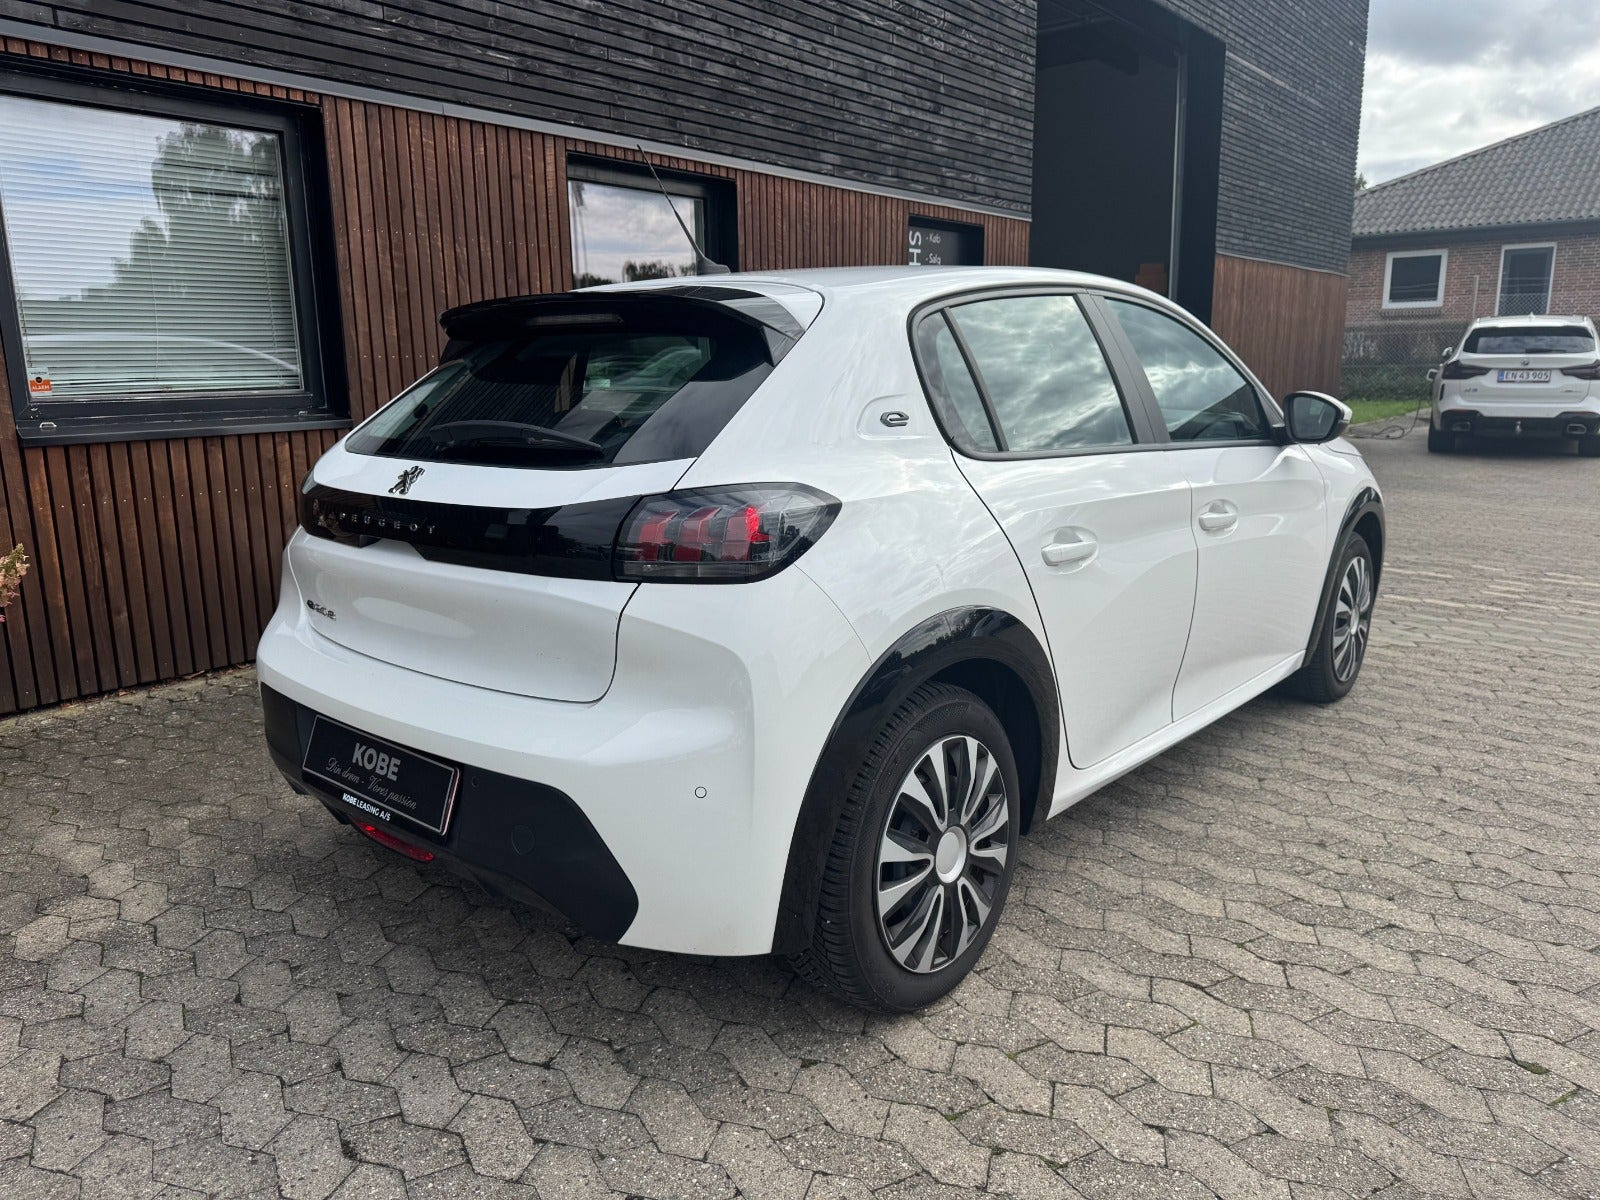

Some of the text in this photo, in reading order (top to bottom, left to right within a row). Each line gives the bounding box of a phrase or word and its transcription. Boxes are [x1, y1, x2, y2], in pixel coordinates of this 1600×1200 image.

[1505, 370, 1549, 380] EN 43 905
[339, 512, 436, 534] PEUGEOT
[352, 742, 402, 782] KOBE
[325, 757, 341, 774] Din
[367, 775, 389, 797] Vores
[384, 790, 417, 810] passion
[342, 792, 391, 822] KOBE LEASING A/S
